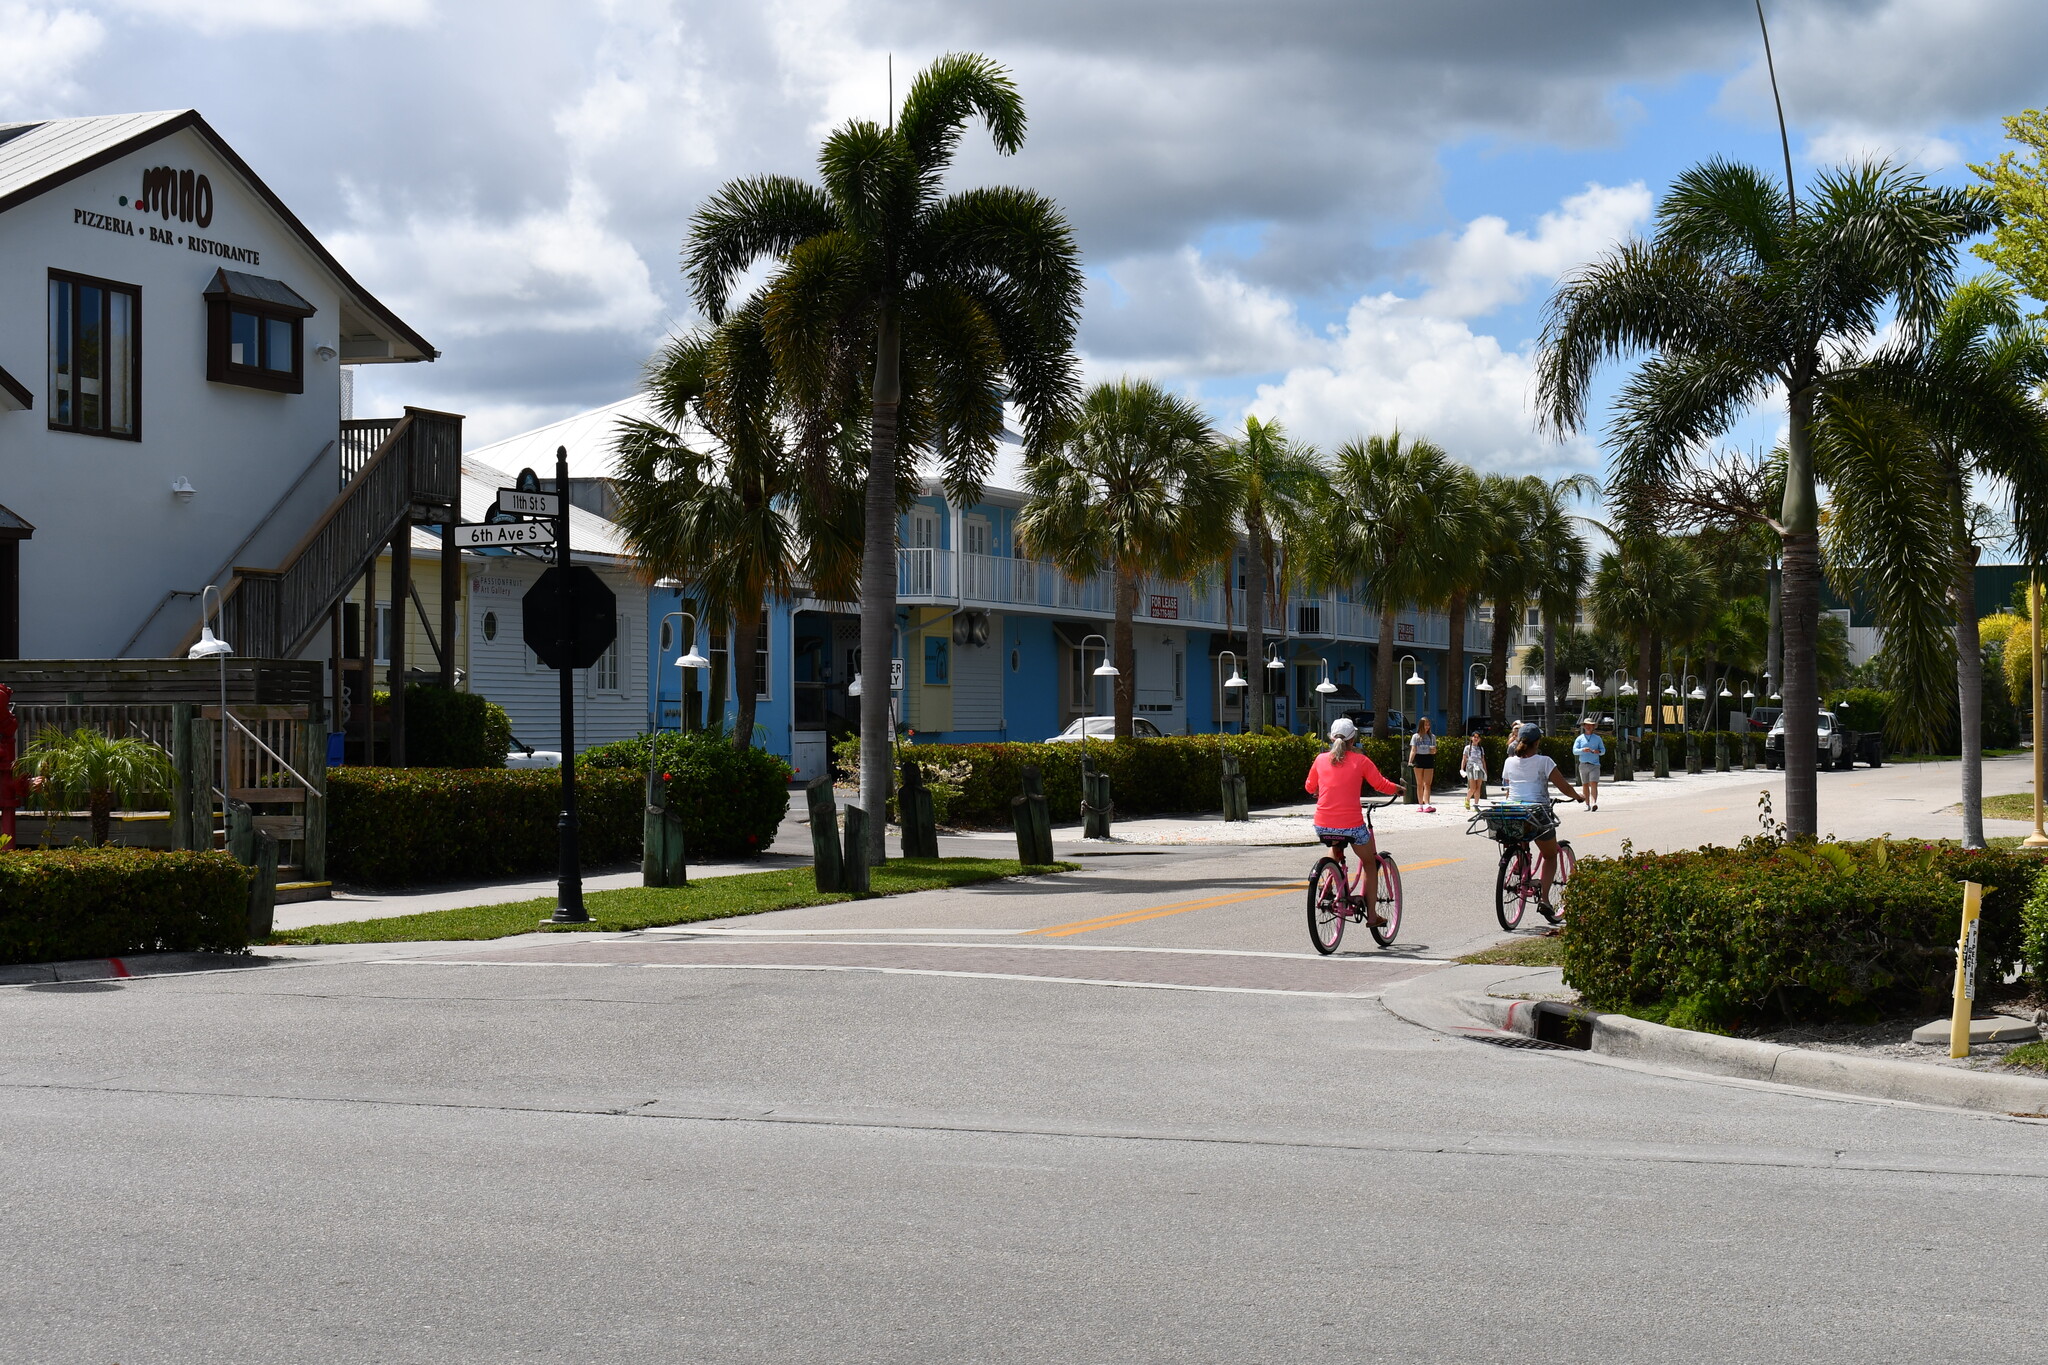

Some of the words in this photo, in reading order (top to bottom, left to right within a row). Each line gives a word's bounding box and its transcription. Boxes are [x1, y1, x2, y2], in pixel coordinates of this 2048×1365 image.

[74, 208, 134, 236] PIZZERIA
[150, 227, 174, 245] BAR
[188, 236, 260, 265] RISTORANTE
[512, 495, 527, 510] 11th
[530, 497, 538, 511] St
[540, 498, 546, 511] S
[471, 529, 493, 542] 6th
[498, 527, 523, 541] Ave
[529, 526, 537, 540] S
[481, 577, 522, 587] PASSIONFRUIT
[481, 586, 490, 594] Art
[491, 586, 511, 597] Gallery
[1152, 596, 1161, 608] FOR
[1162, 597, 1177, 609] LEASE
[1969, 931, 1977, 986] PIPELINE
